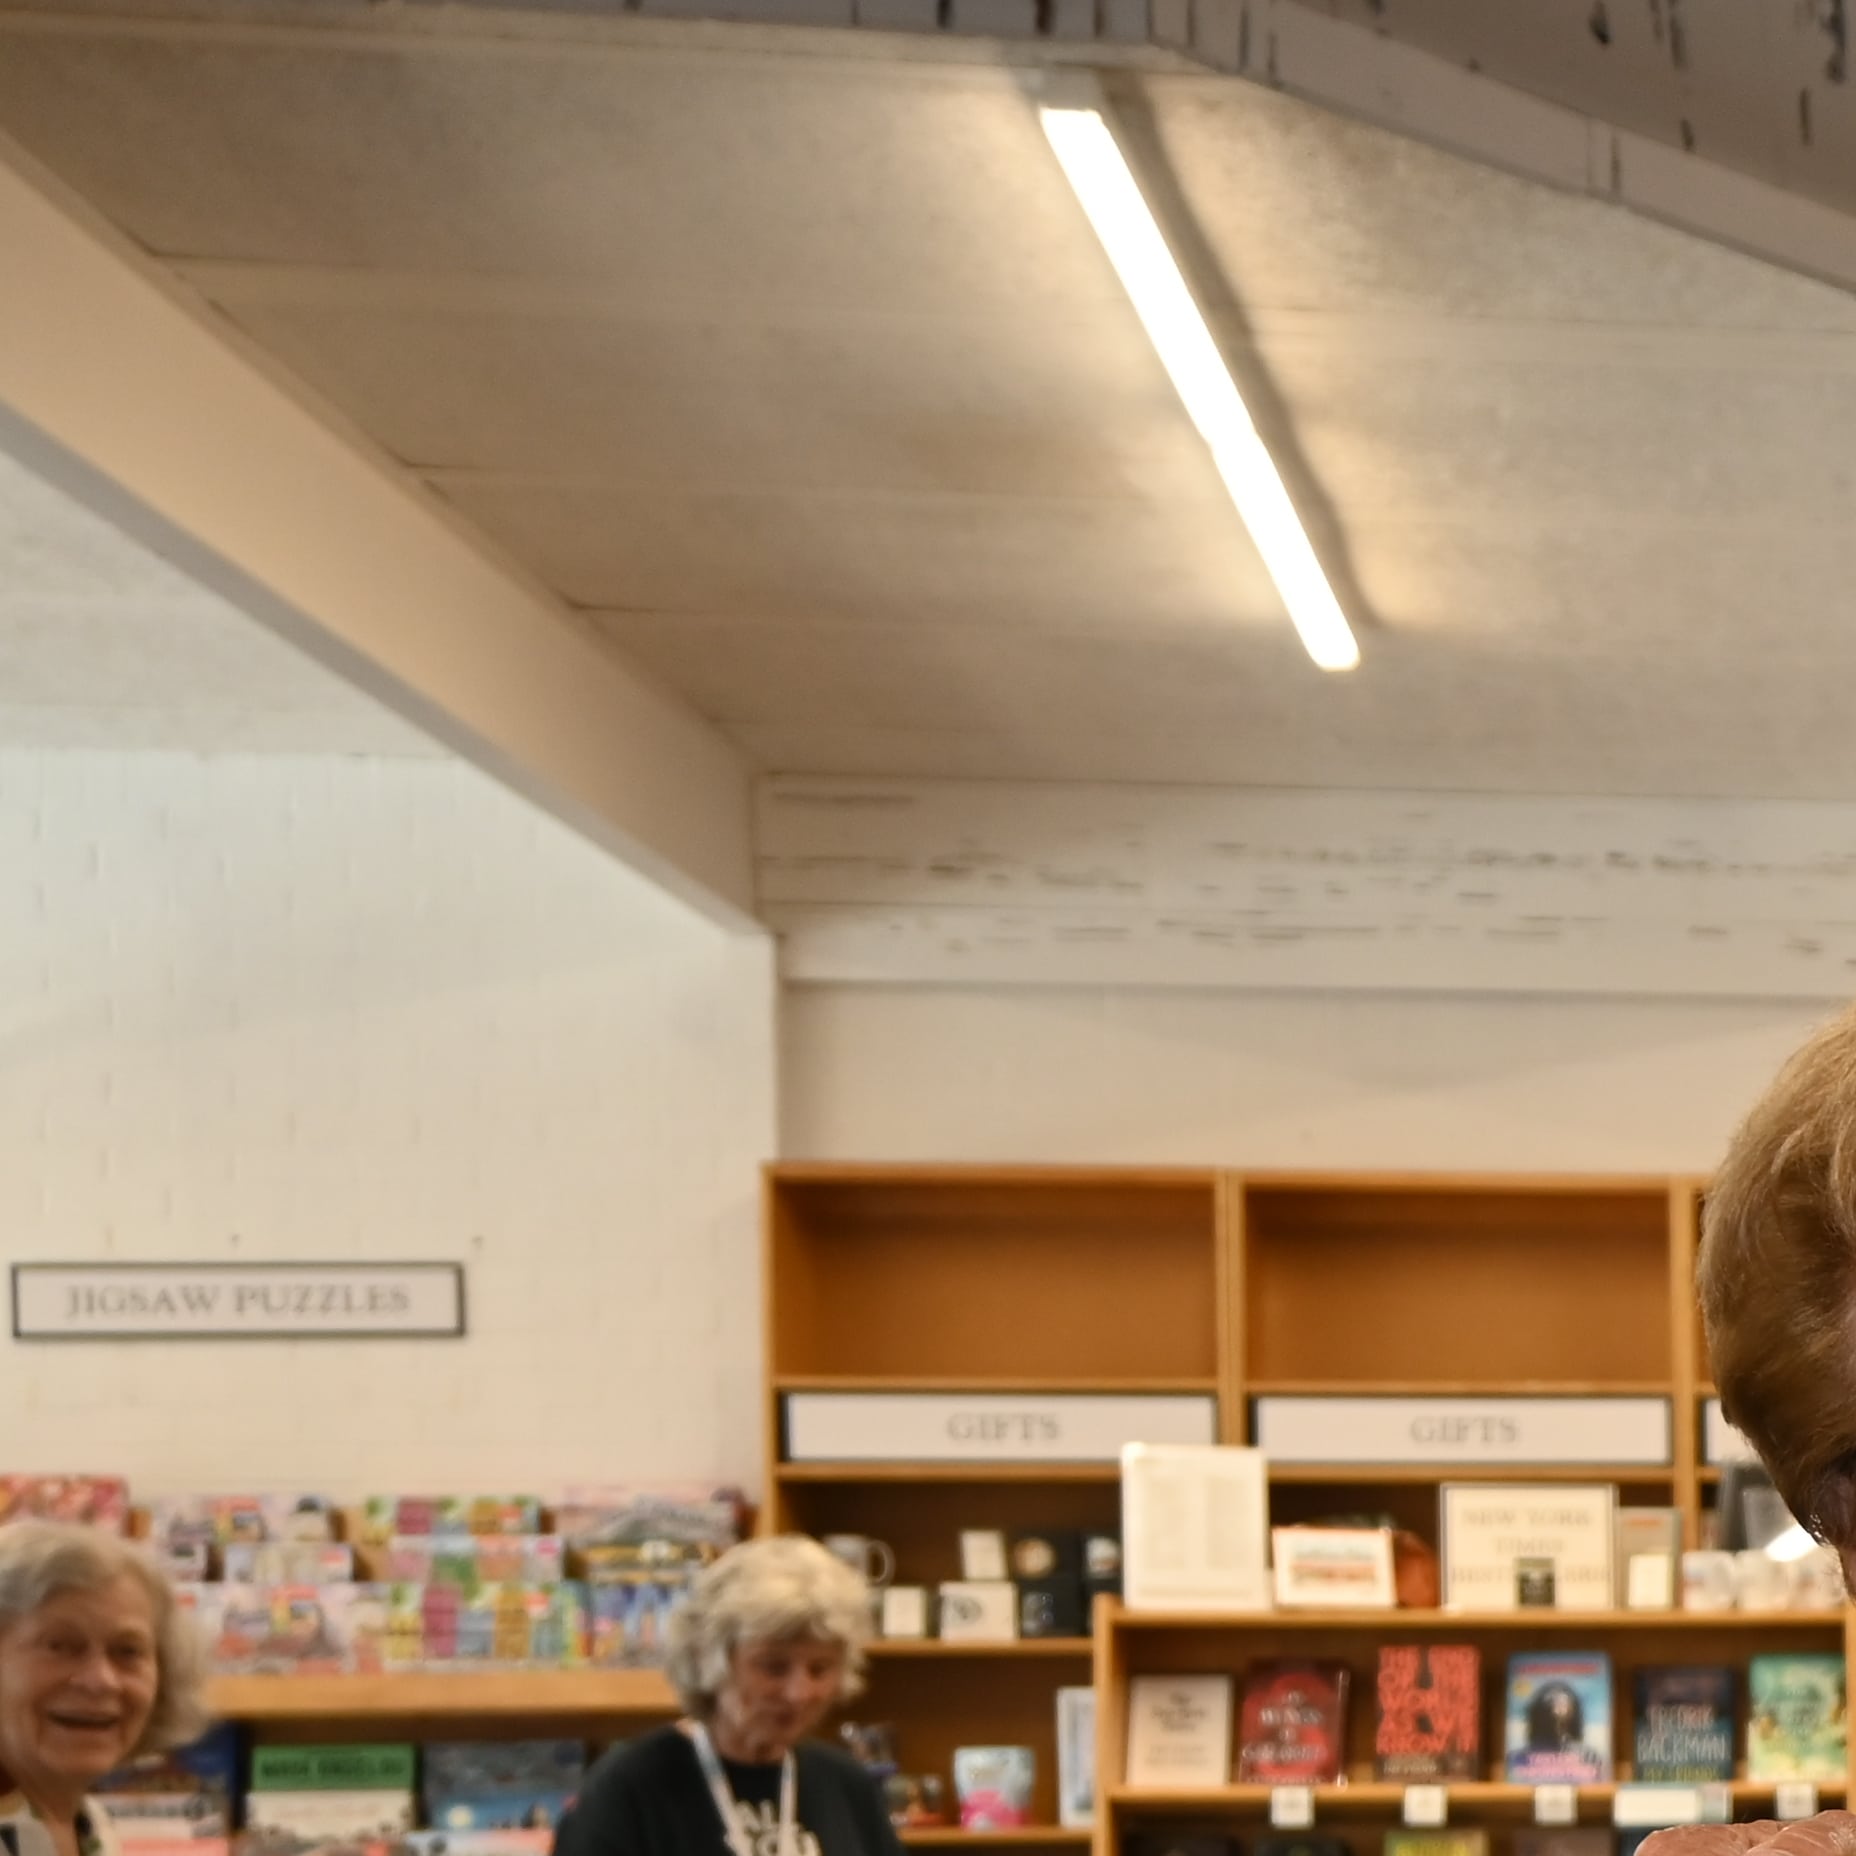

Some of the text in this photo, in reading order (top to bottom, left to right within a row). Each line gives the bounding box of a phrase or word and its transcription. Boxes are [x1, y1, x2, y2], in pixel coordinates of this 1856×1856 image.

[66, 1284, 410, 1319] JIGSAW PUZZLES
[947, 1413, 1061, 1442] GIFTS
[1408, 1415, 1519, 1445] GIFTS
